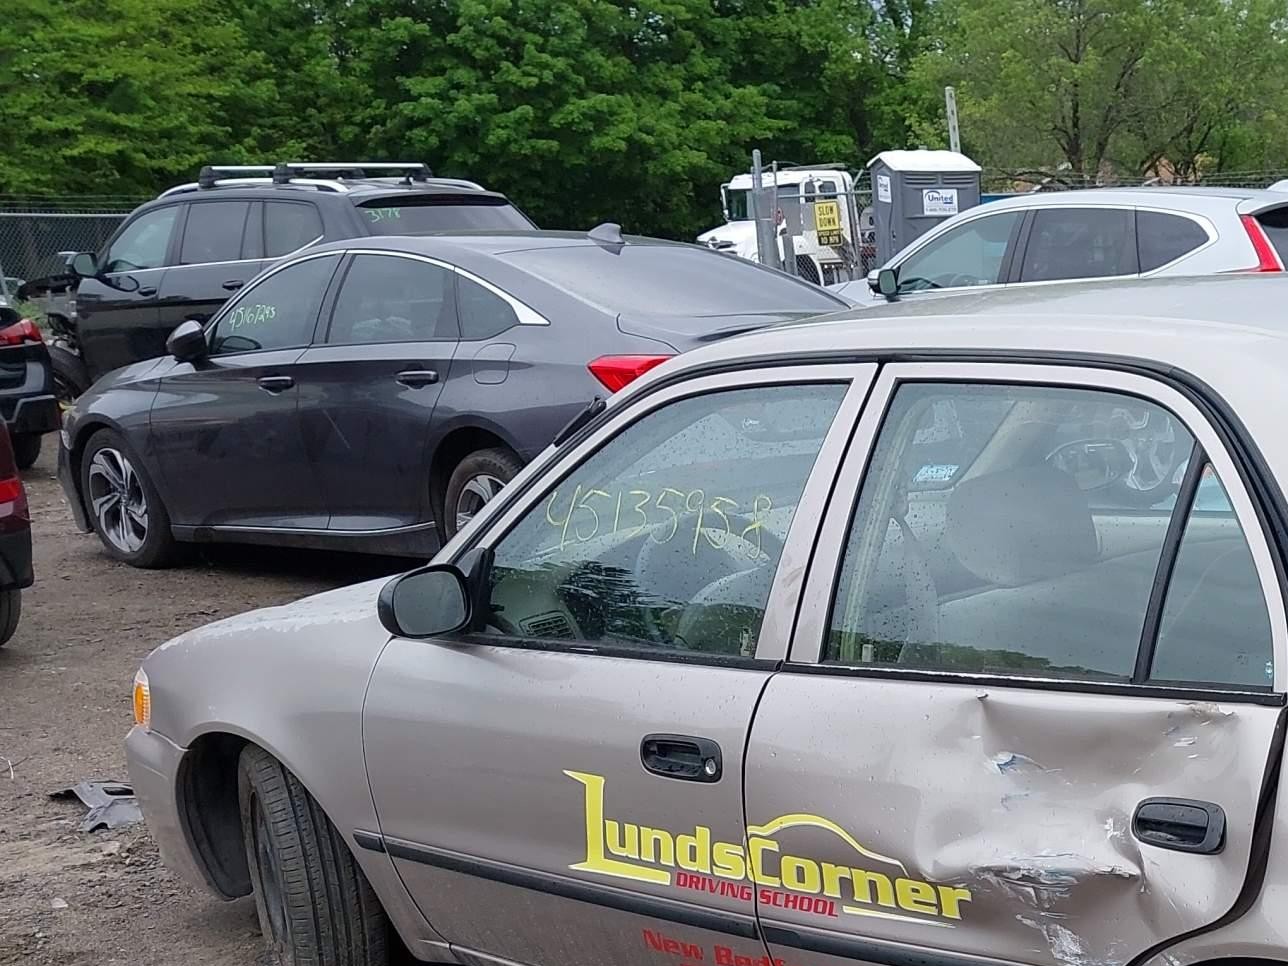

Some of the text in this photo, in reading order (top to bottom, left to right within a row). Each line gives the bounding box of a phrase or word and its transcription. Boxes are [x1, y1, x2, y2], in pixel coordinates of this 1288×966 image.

[928, 194, 954, 202] United
[818, 205, 834, 216] SLOW
[819, 217, 837, 228] DOWN
[546, 485, 773, 558] 45135958
[676, 872, 838, 918] DRIVING SCHOOL
[642, 928, 704, 961] New
